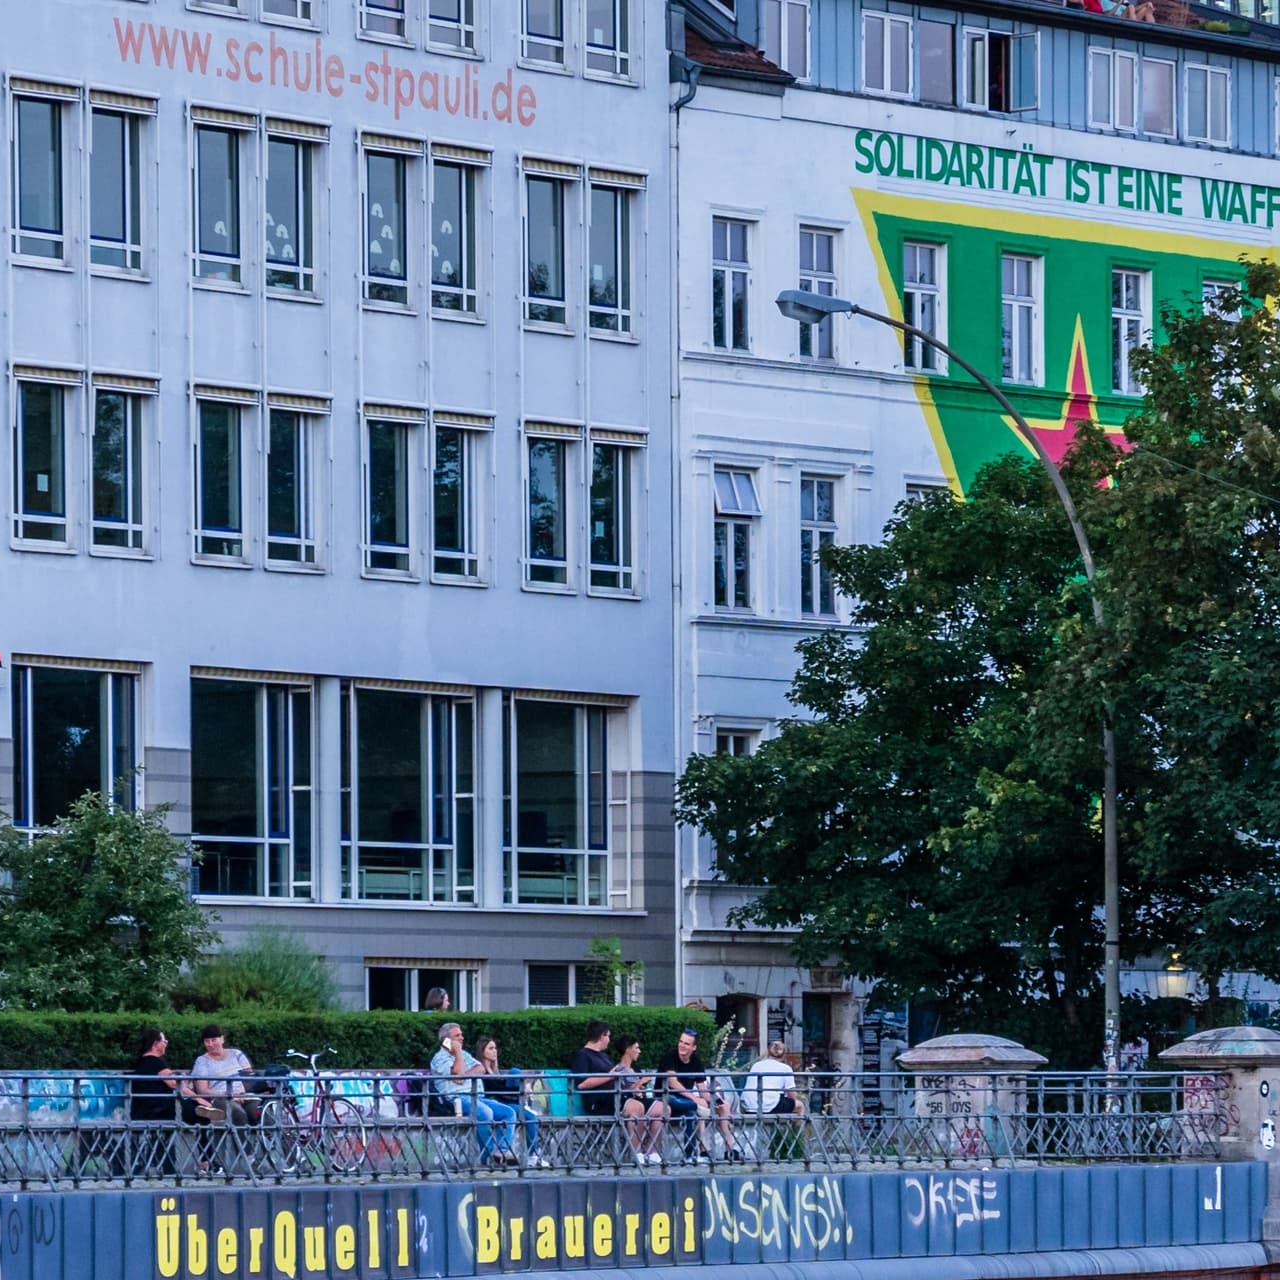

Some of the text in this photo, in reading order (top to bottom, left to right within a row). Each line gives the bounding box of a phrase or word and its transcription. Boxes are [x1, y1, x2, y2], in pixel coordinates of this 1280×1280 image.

[113, 17, 537, 127] www.schule-stpauli.de
[854, 129, 1053, 197] SOLIDARITÄT
[1066, 158, 1111, 204] IST
[1118, 168, 1182, 216] EINE
[156, 1197, 698, 1279] ÜberQuell Brauerei
